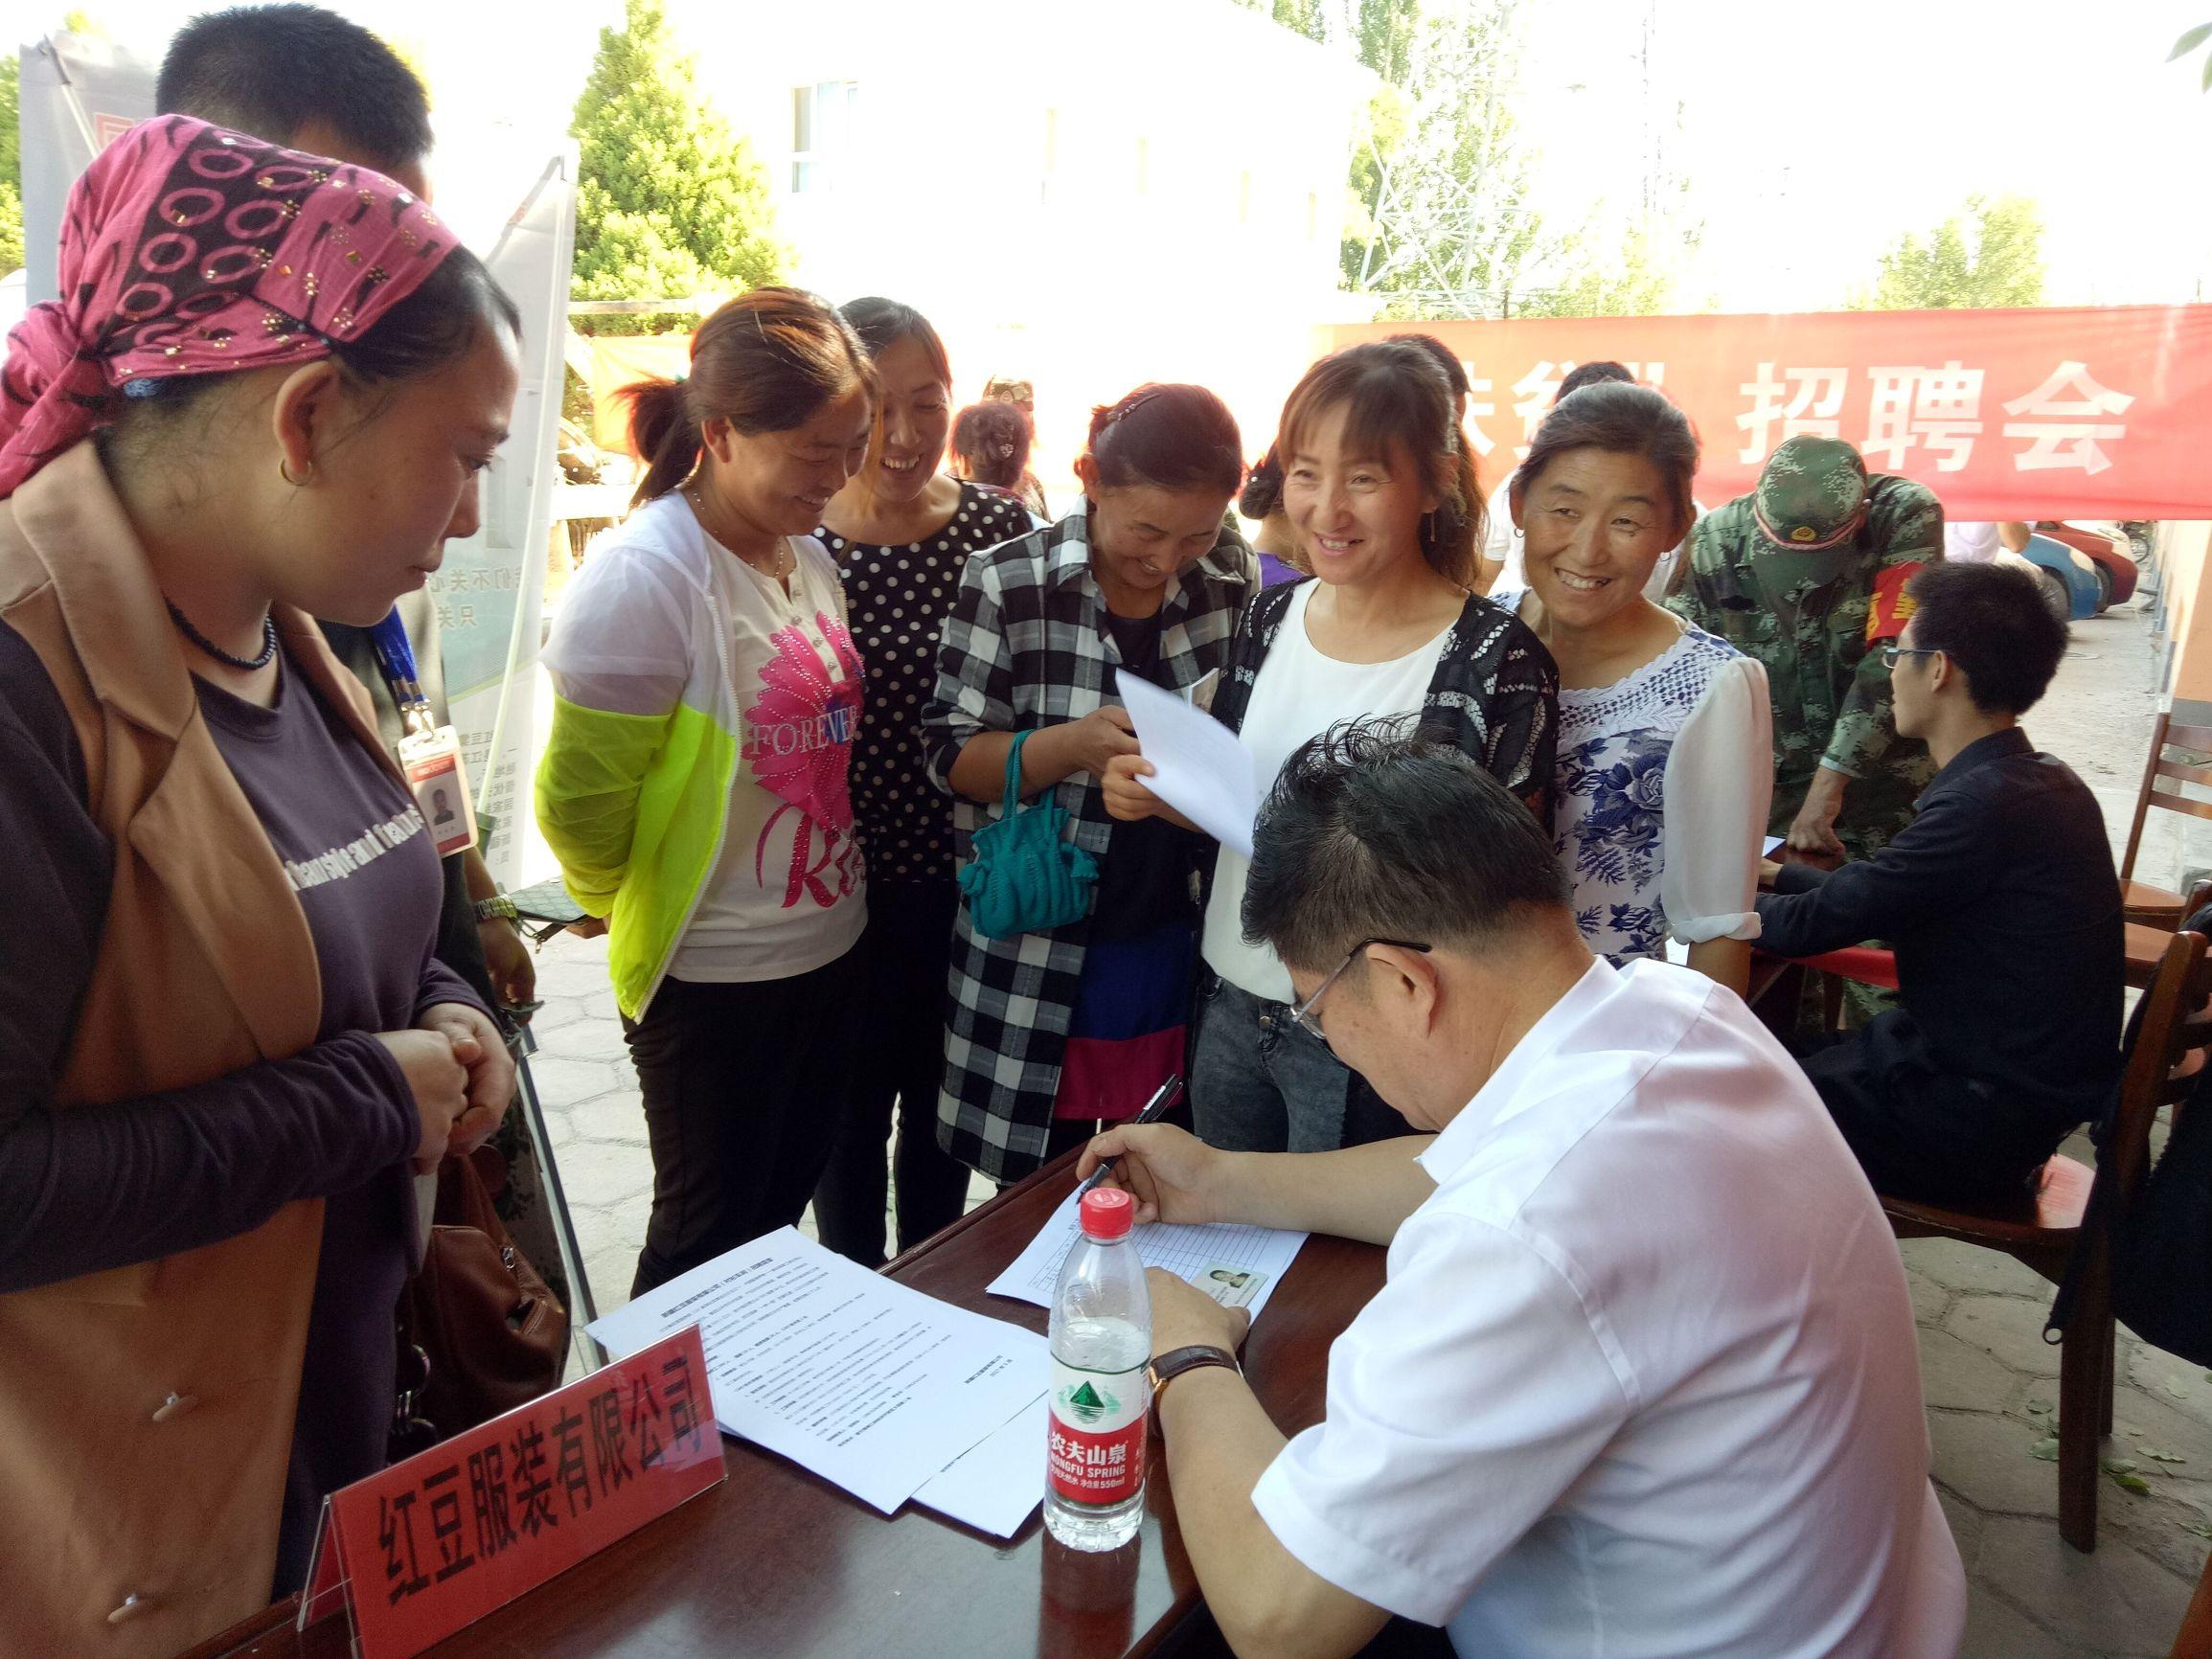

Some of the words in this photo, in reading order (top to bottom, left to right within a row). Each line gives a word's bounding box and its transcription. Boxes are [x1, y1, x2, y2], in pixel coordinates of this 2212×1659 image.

[1736, 360, 2136, 476] 招聘会
[378, 1354, 703, 1606] 红豆服装有限公司
[1050, 1431, 1127, 1466] 农夫山泉
[1050, 1452, 1084, 1476] NONGFU
[1087, 1465, 1126, 1478] SPRING
